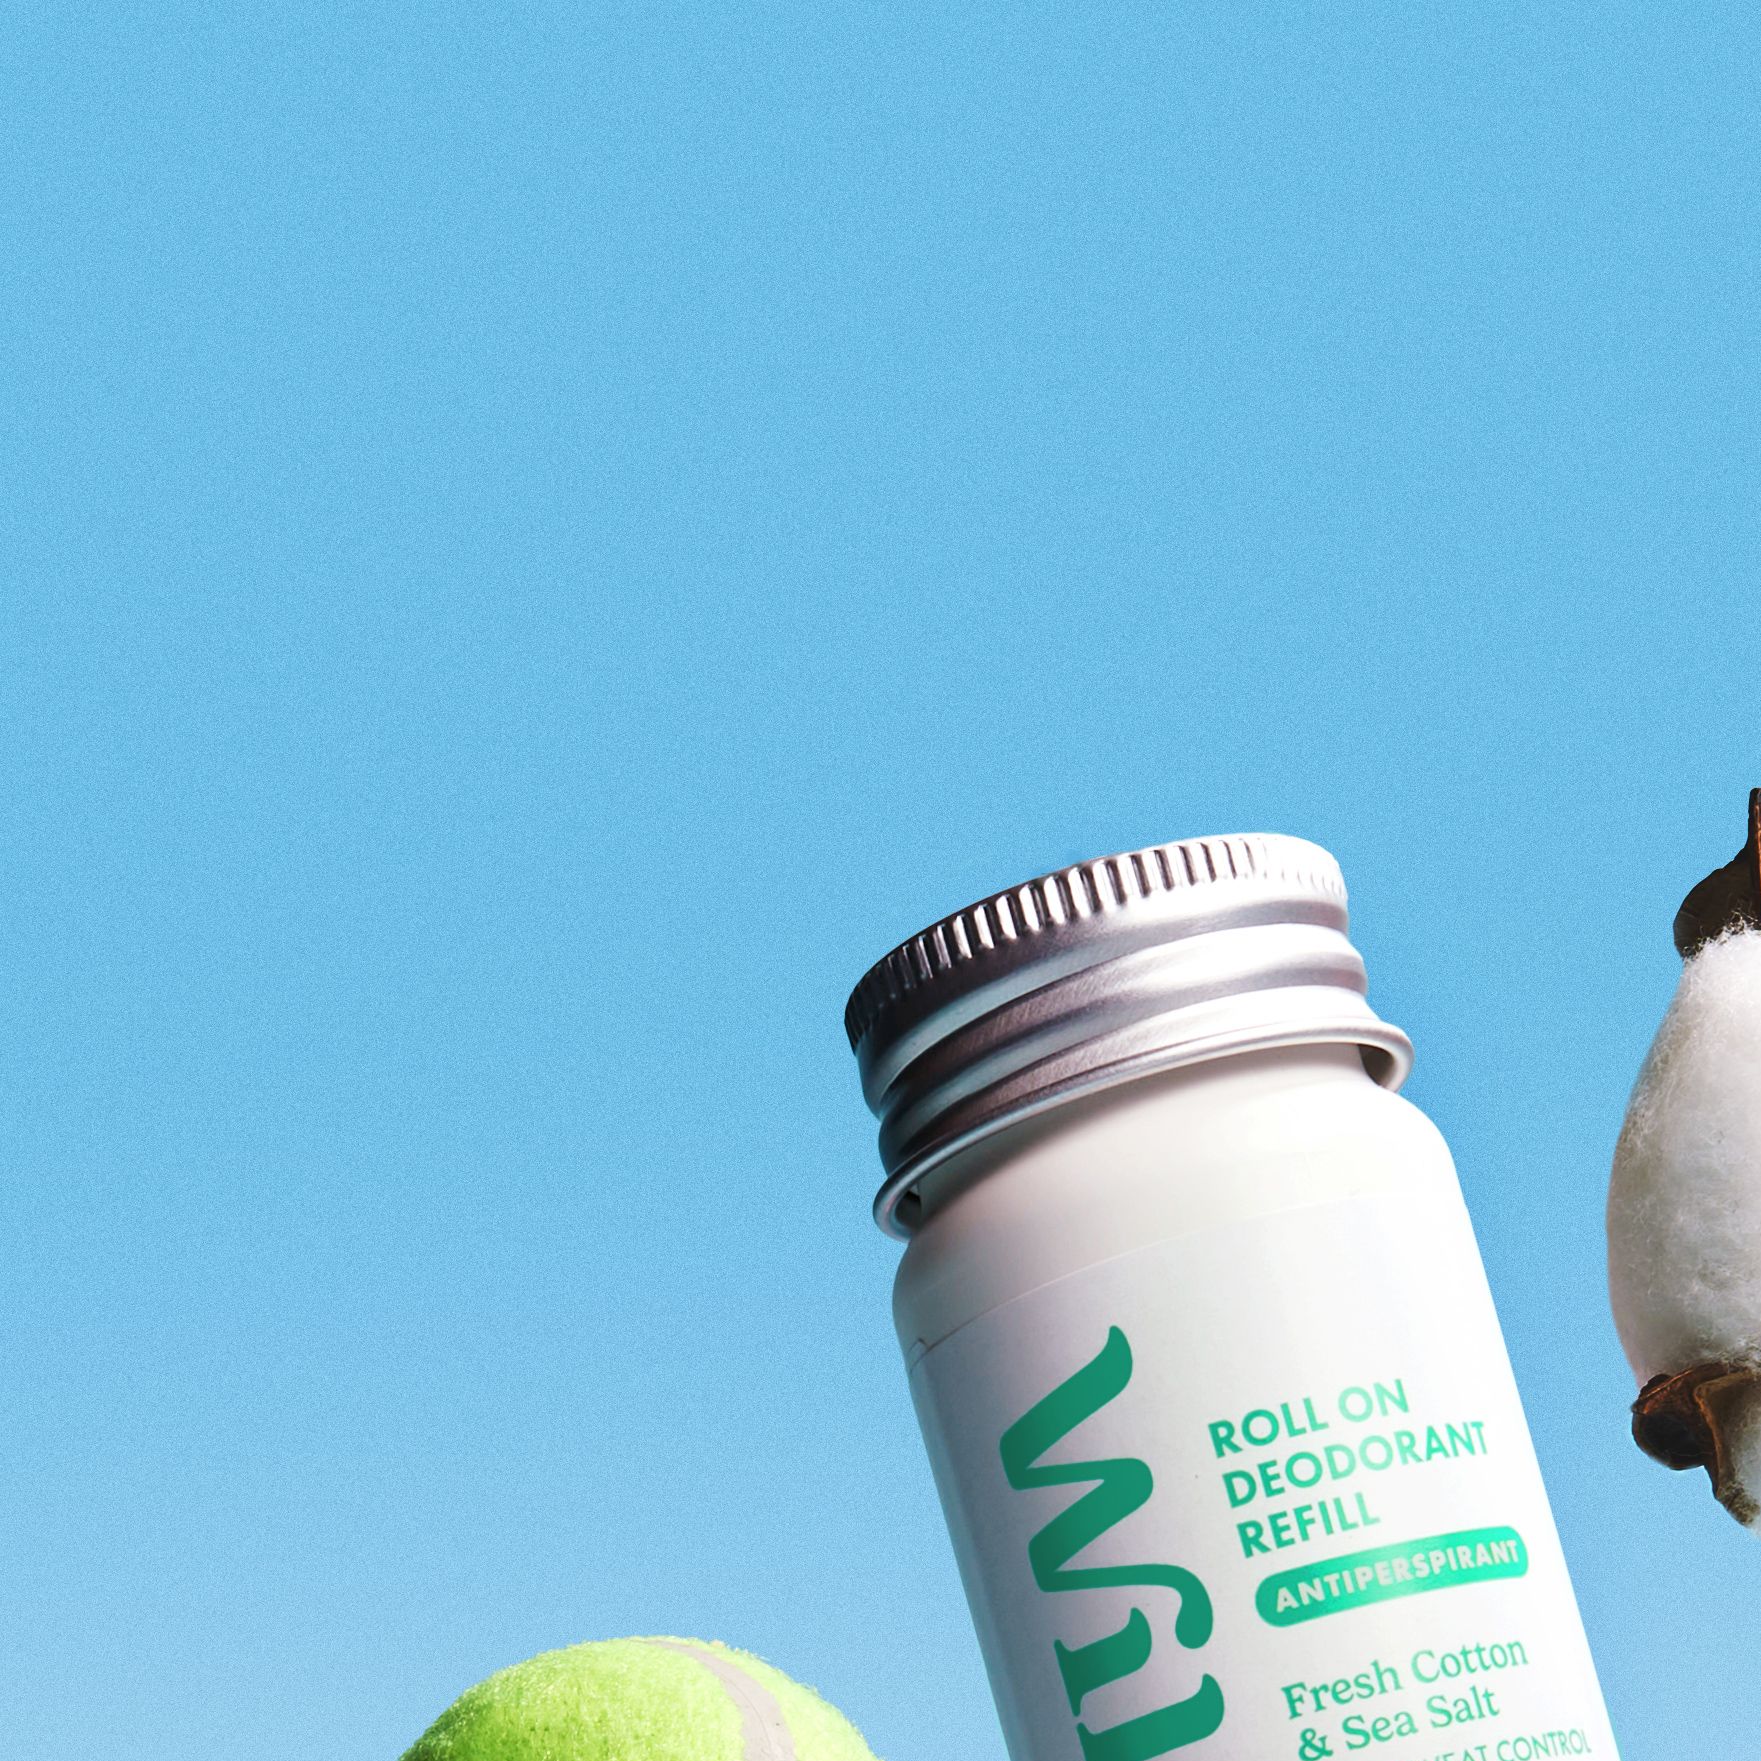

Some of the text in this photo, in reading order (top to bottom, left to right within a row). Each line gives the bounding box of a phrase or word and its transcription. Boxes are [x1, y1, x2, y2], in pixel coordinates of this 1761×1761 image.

[1207, 1378, 1410, 1458] ROLL ON
[1221, 1421, 1489, 1509] DEODORANT
[1236, 1492, 1381, 1558] REFILL
[1275, 1540, 1520, 1613] ANTIPERSPIRANT
[1281, 1640, 1529, 1720] Fresh Cotton
[1341, 1709, 1418, 1751] Sea
[1426, 1686, 1501, 1729] Salt
